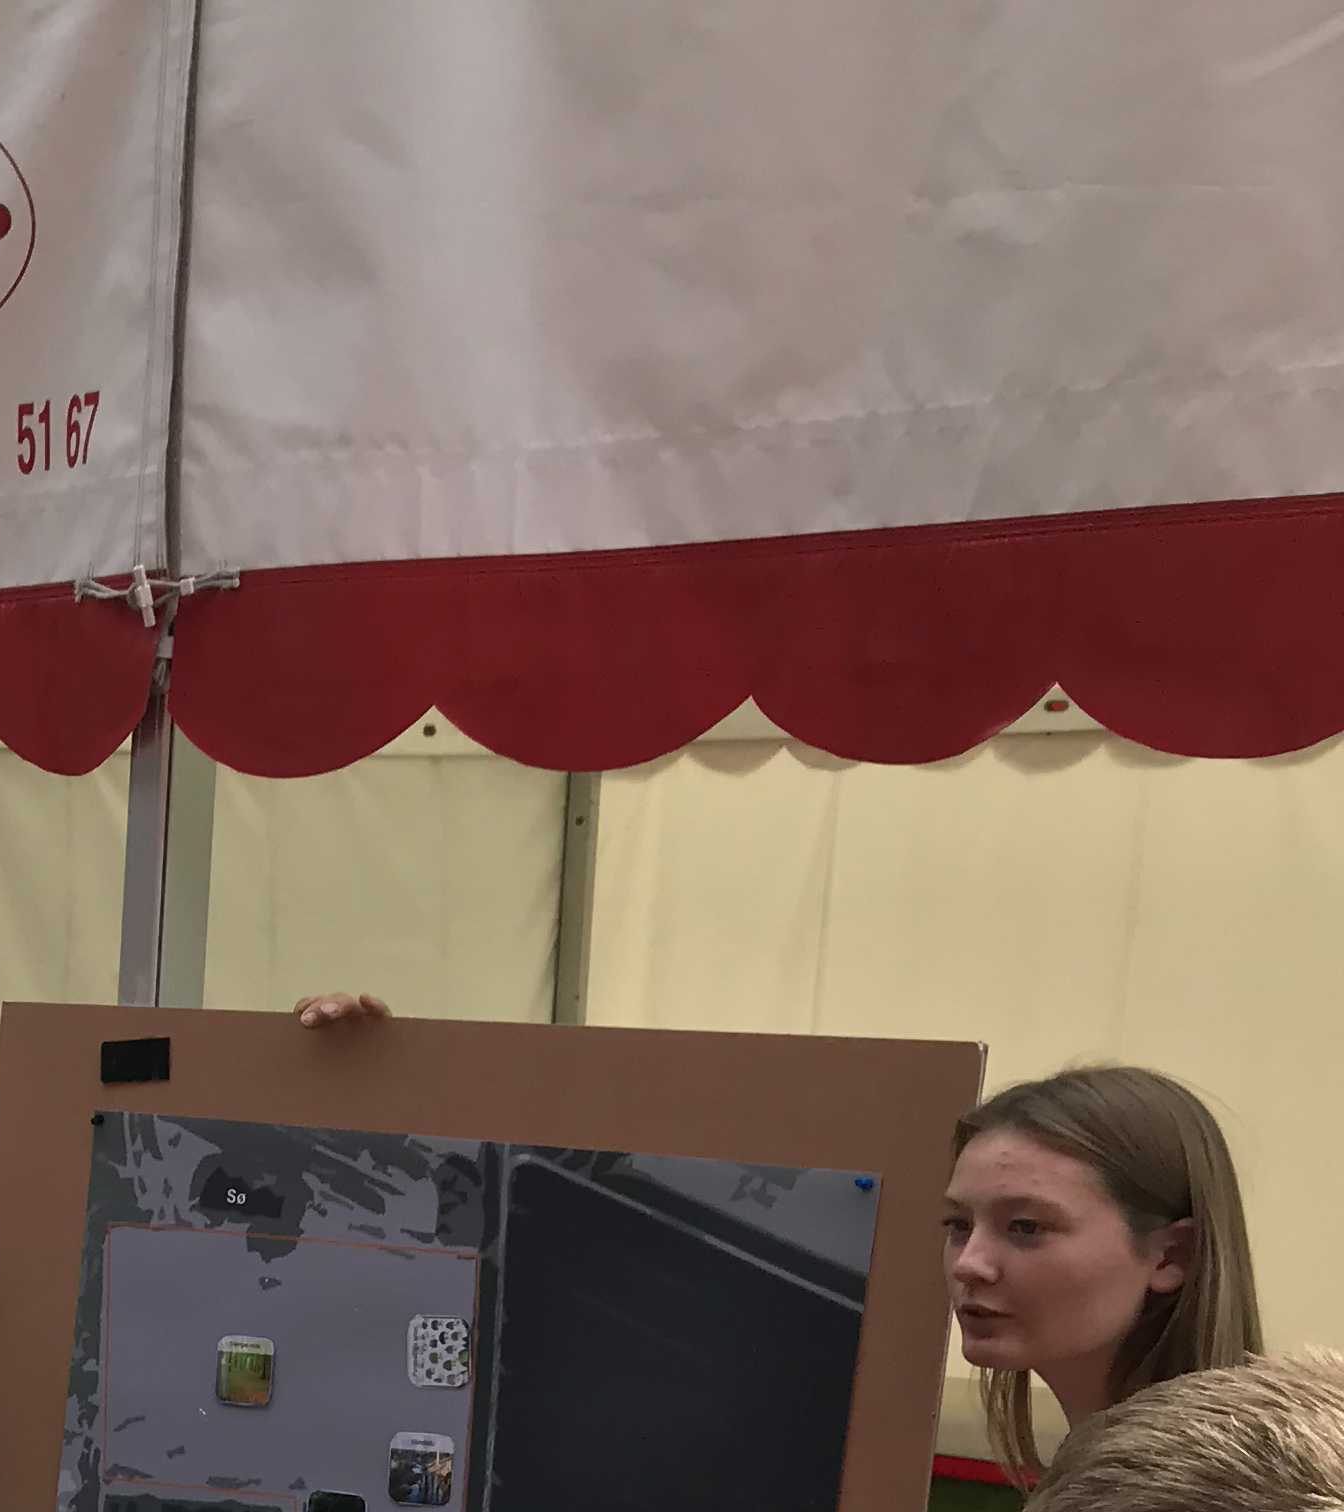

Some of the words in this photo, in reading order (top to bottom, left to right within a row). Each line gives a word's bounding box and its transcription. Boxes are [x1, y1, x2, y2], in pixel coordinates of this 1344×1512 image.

[15, 399, 51, 474] 51
[65, 391, 101, 468] 67
[226, 1188, 247, 1205] Sø
